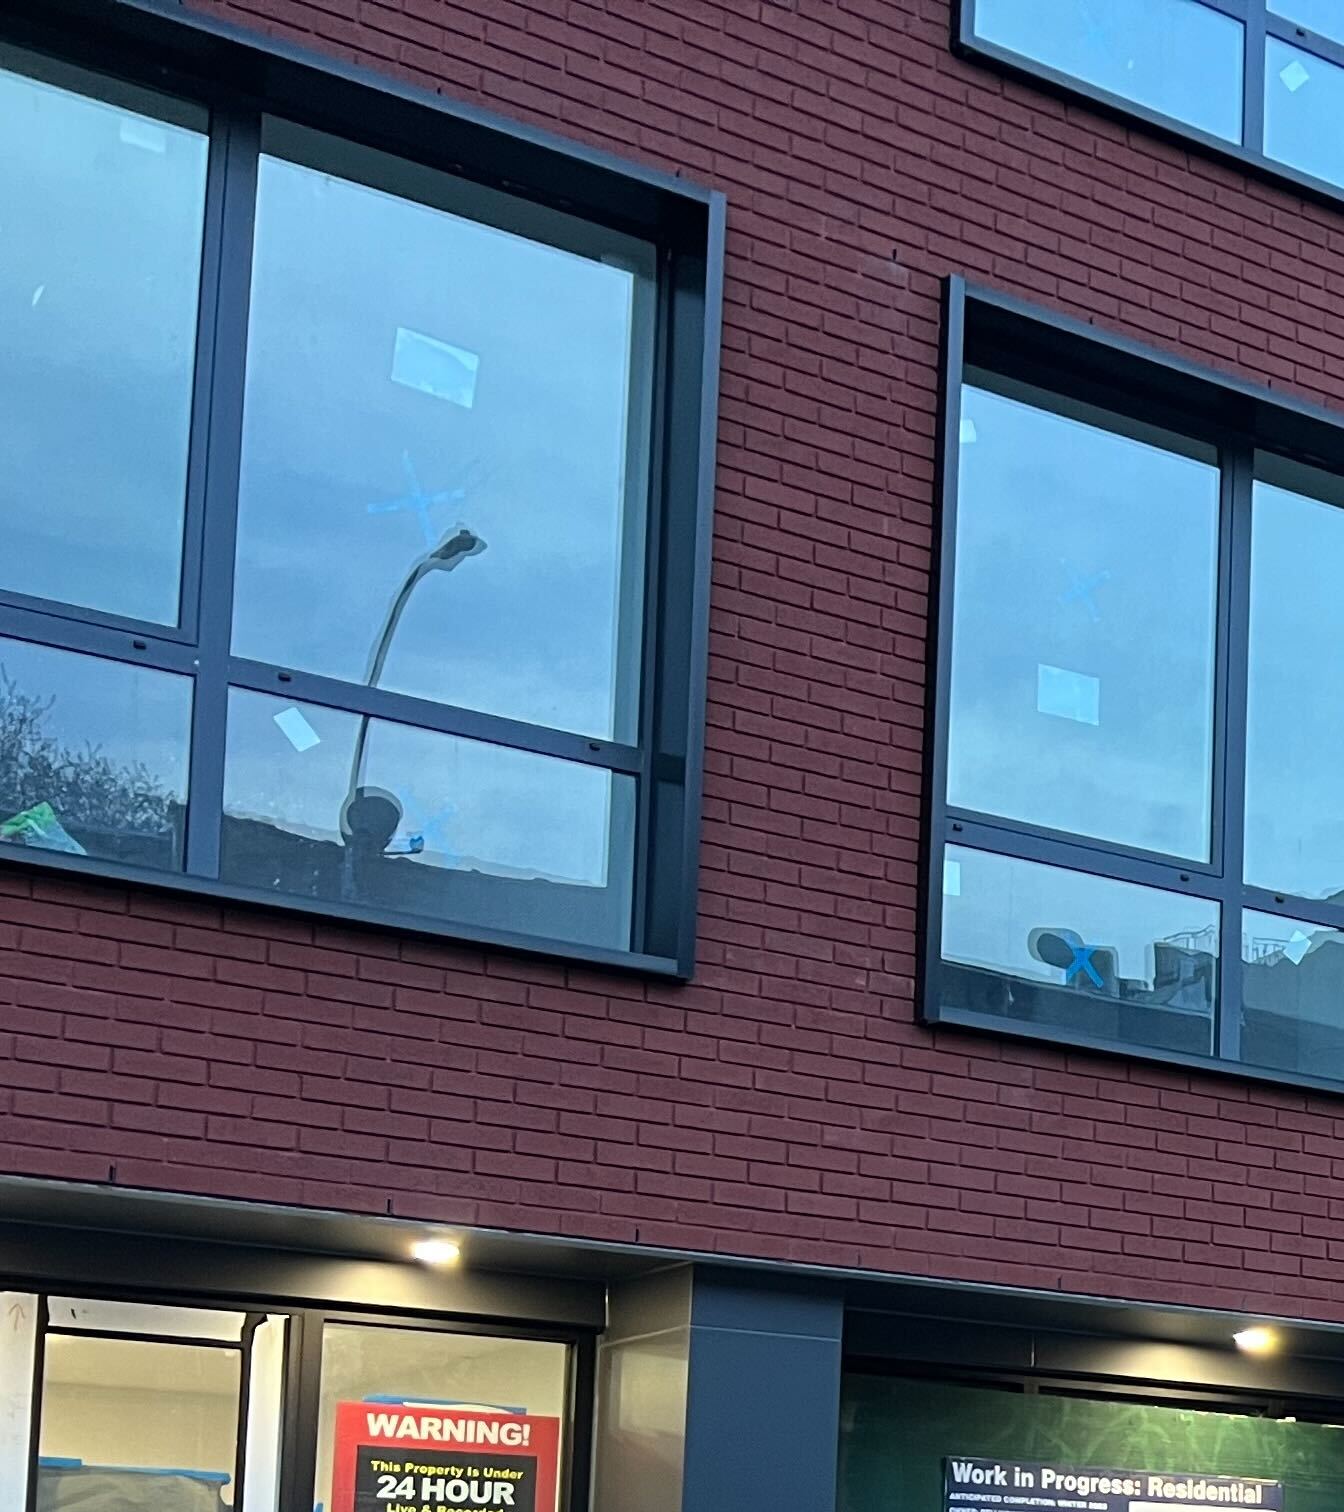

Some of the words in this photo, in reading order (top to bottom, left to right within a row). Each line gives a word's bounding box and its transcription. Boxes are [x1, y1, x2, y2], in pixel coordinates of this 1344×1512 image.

[367, 1413, 531, 1446] WARNING!
[371, 1460, 400, 1472] This
[405, 1463, 463, 1478] Property
[484, 1467, 523, 1480] Under
[952, 1462, 1008, 1486] Work
[1014, 1467, 1034, 1488] in
[1041, 1468, 1140, 1496] Progress:
[1148, 1476, 1263, 1504] Residential
[376, 1475, 416, 1500] 24
[421, 1477, 515, 1505] HOUR
